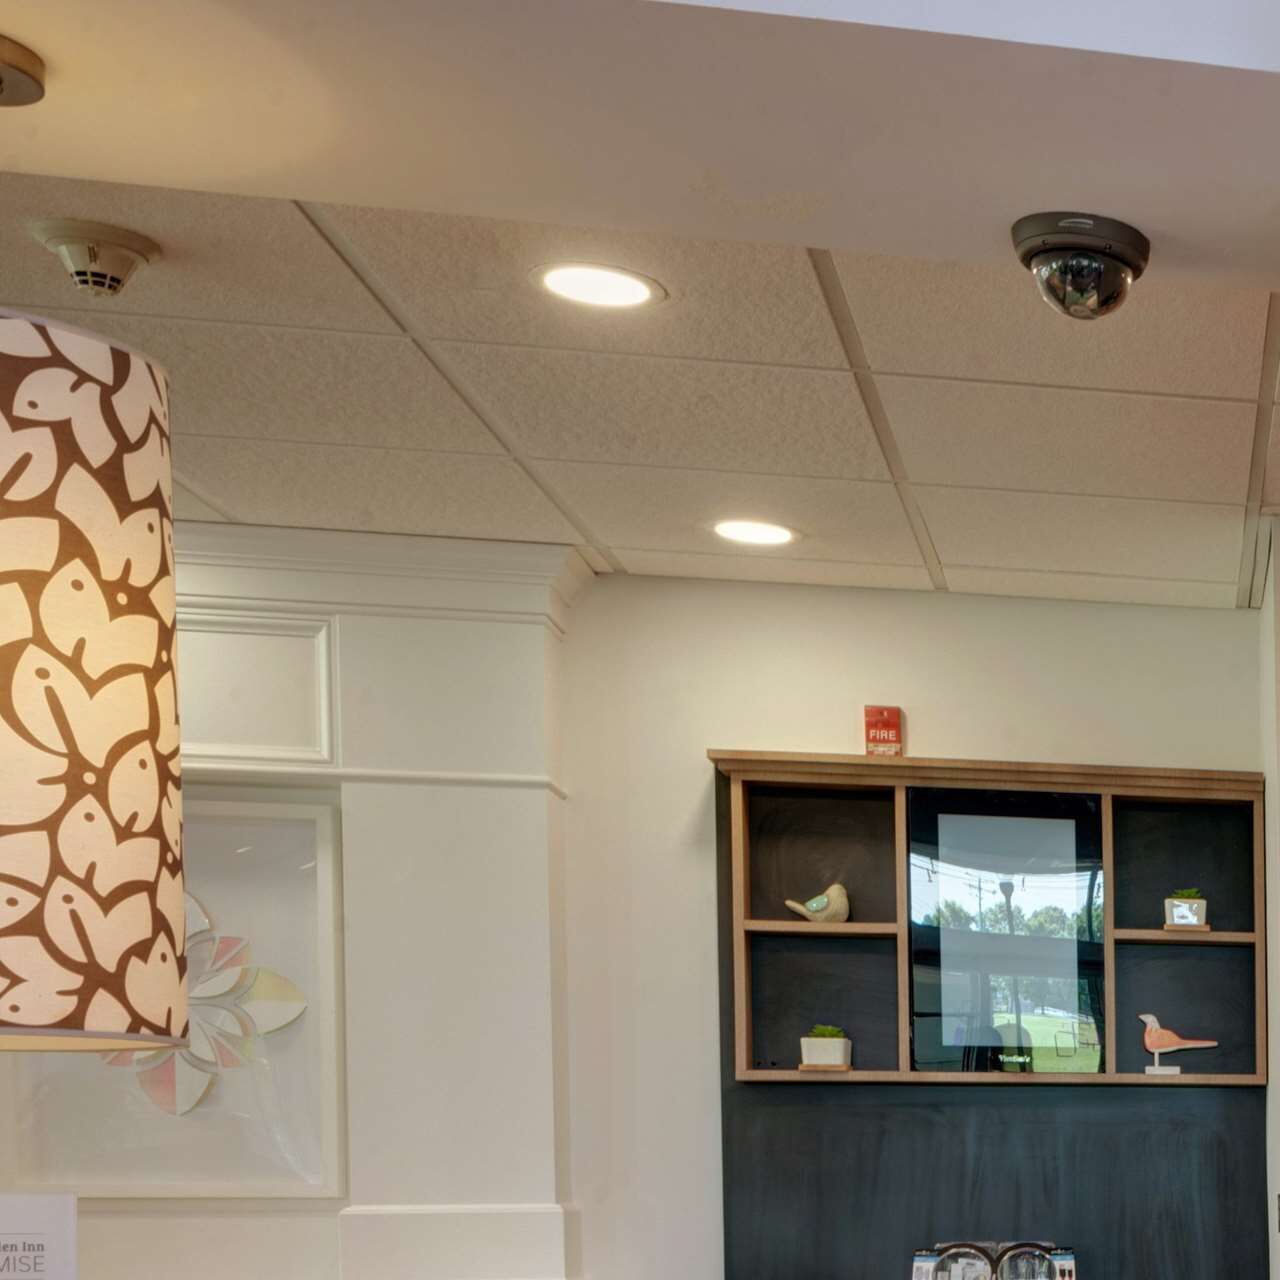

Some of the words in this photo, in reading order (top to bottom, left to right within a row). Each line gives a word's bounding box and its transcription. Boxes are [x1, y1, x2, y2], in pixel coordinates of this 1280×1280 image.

[869, 729, 896, 740] FIRE
[22, 1242, 45, 1252] Inn
[0, 1255, 46, 1273] MISE
